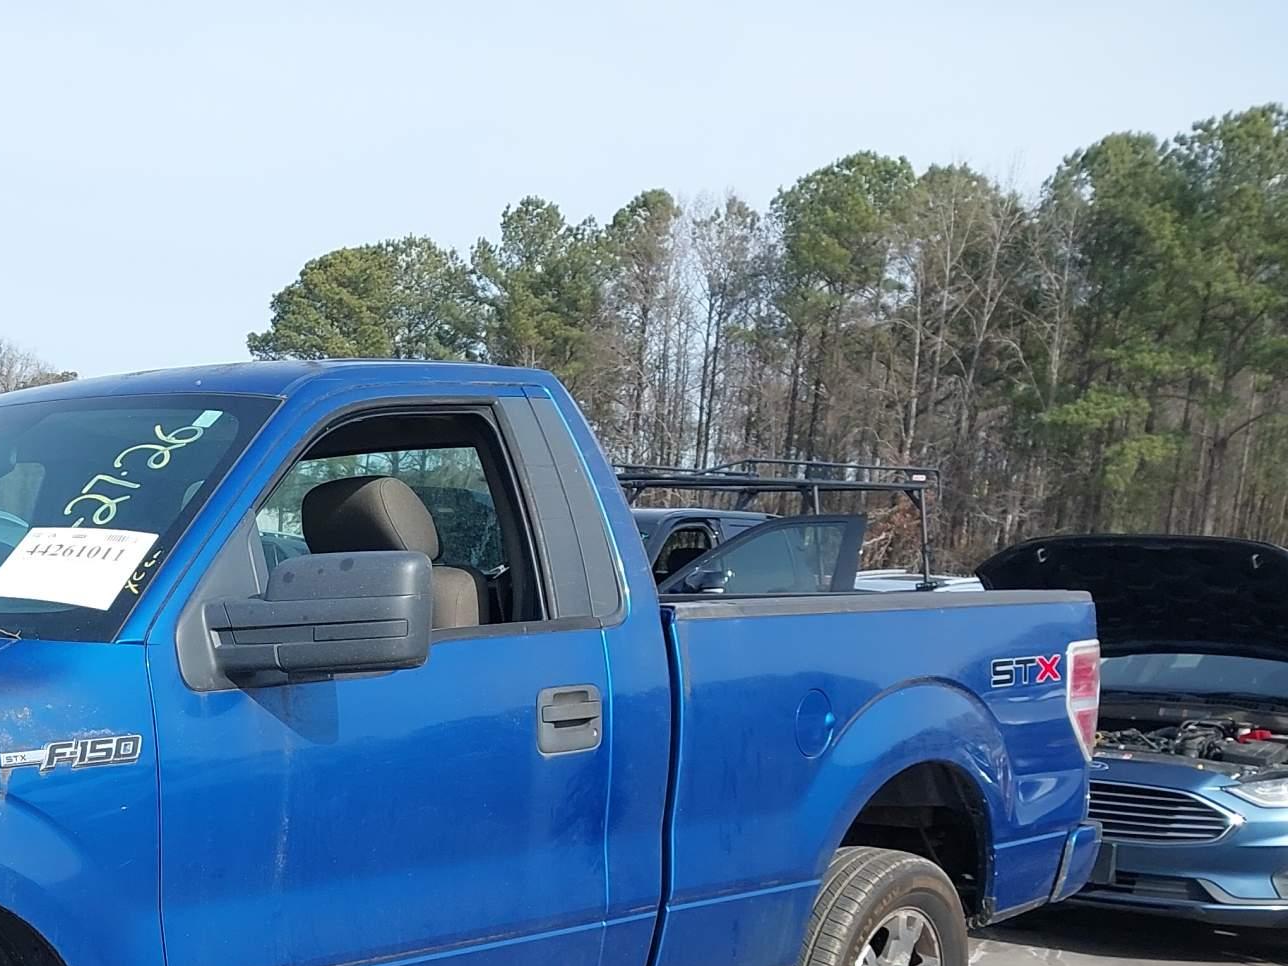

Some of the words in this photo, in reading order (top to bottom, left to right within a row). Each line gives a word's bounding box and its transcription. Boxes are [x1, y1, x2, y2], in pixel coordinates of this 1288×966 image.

[26, 543, 125, 561] 44261011
[991, 654, 1061, 688] STX
[4, 754, 27, 764] STX
[41, 734, 142, 771] F-150
